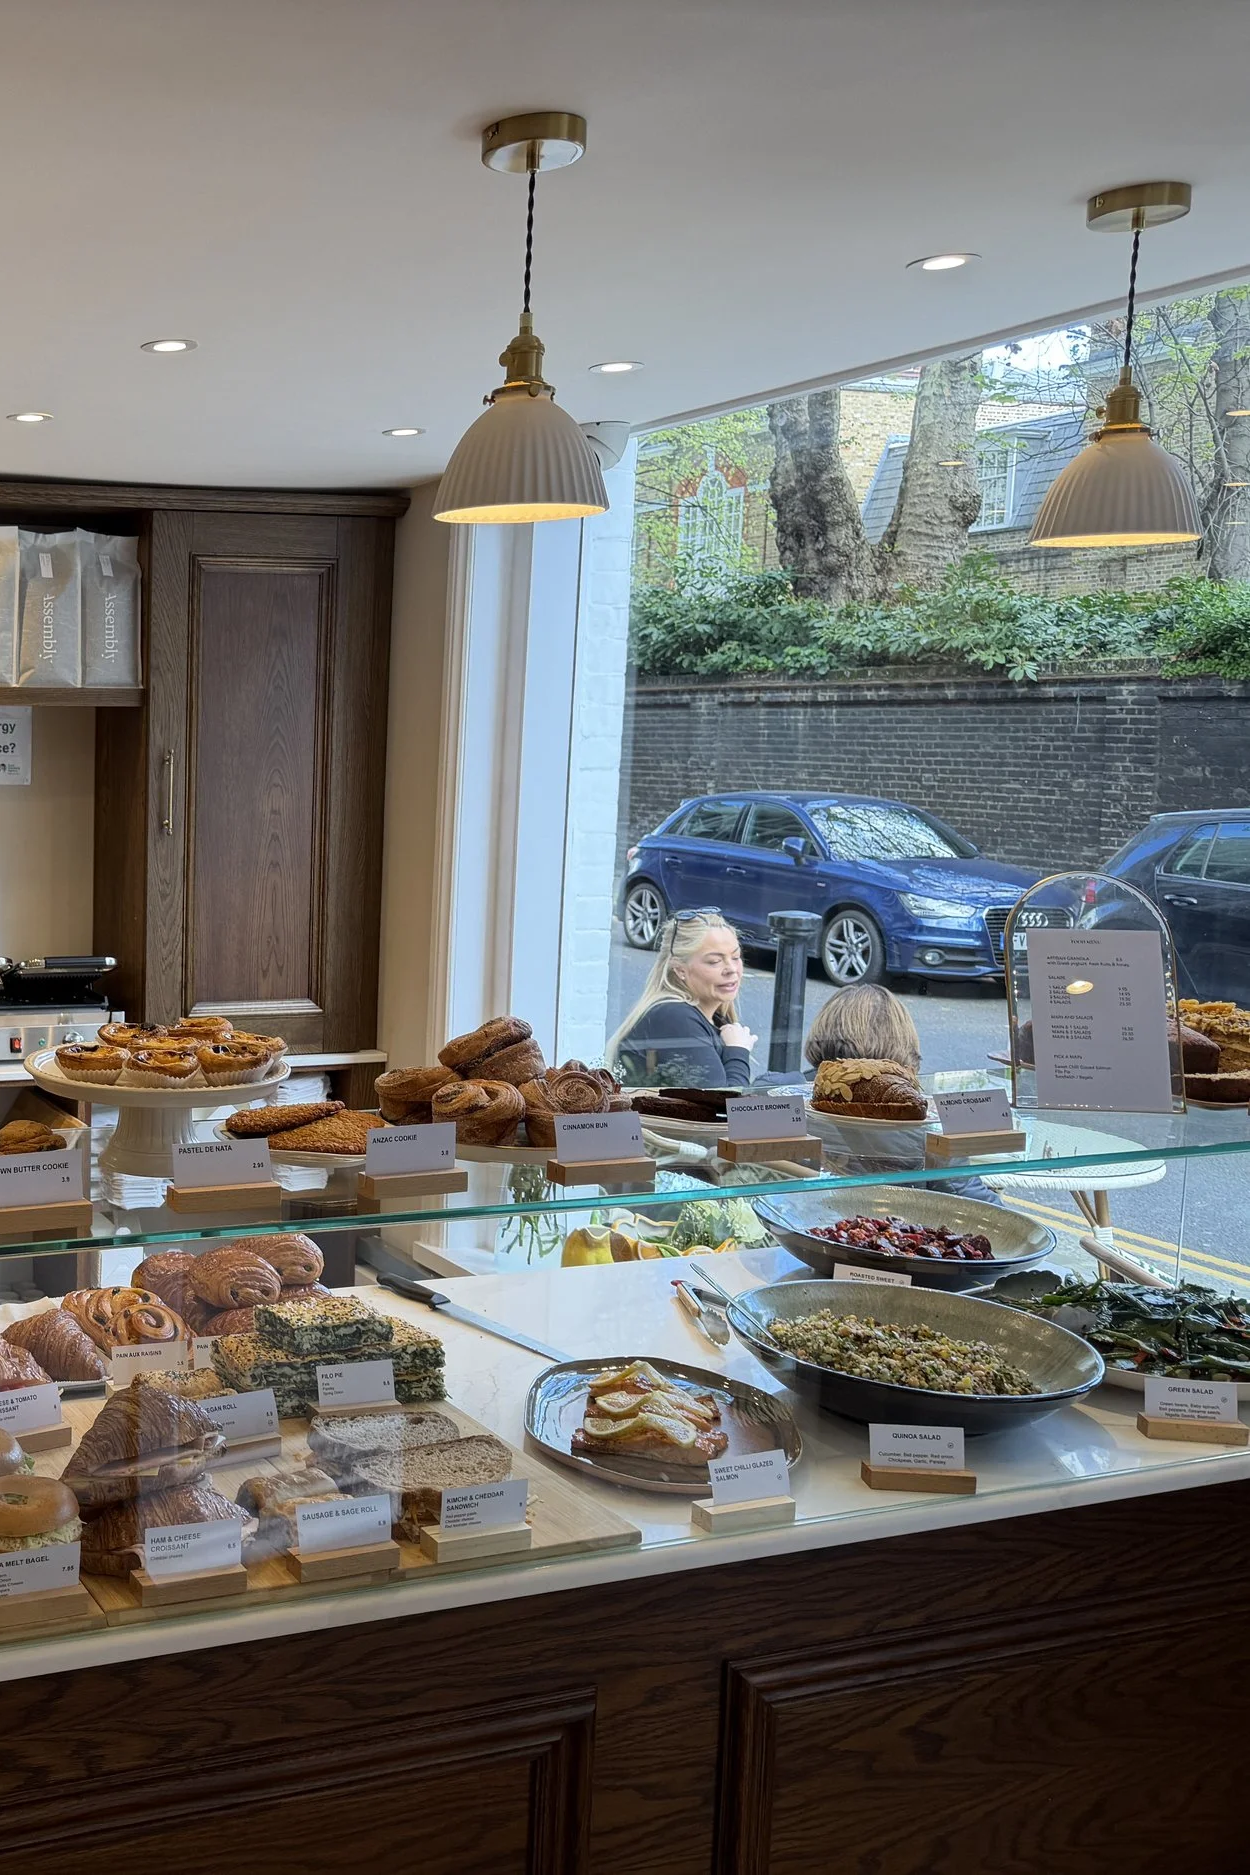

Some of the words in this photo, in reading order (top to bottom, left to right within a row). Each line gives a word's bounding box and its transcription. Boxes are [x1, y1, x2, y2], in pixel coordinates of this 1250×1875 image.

[39, 593, 56, 663] Assembly
[101, 592, 119, 663] Assembly
[14, 1165, 40, 1173] BUTTER
[42, 1162, 69, 1170] COOKIE
[850, 1272, 875, 1280] ROASTED
[15, 1395, 38, 1403] TOMATO
[714, 1466, 733, 1474] SWEET
[734, 1463, 751, 1471] CHILLI
[752, 1460, 773, 1469] GLAZED
[716, 1473, 739, 1482] SALMON
[447, 1496, 468, 1504] KIMCHI
[475, 1491, 504, 1500] CHEDDAR
[446, 1502, 479, 1511] SANDWICH
[302, 1511, 334, 1520] SAUSAGE
[174, 1533, 201, 1541] CHEESE
[151, 1542, 189, 1552] CROISSANT
[26, 1555, 49, 1564] BAGEL
